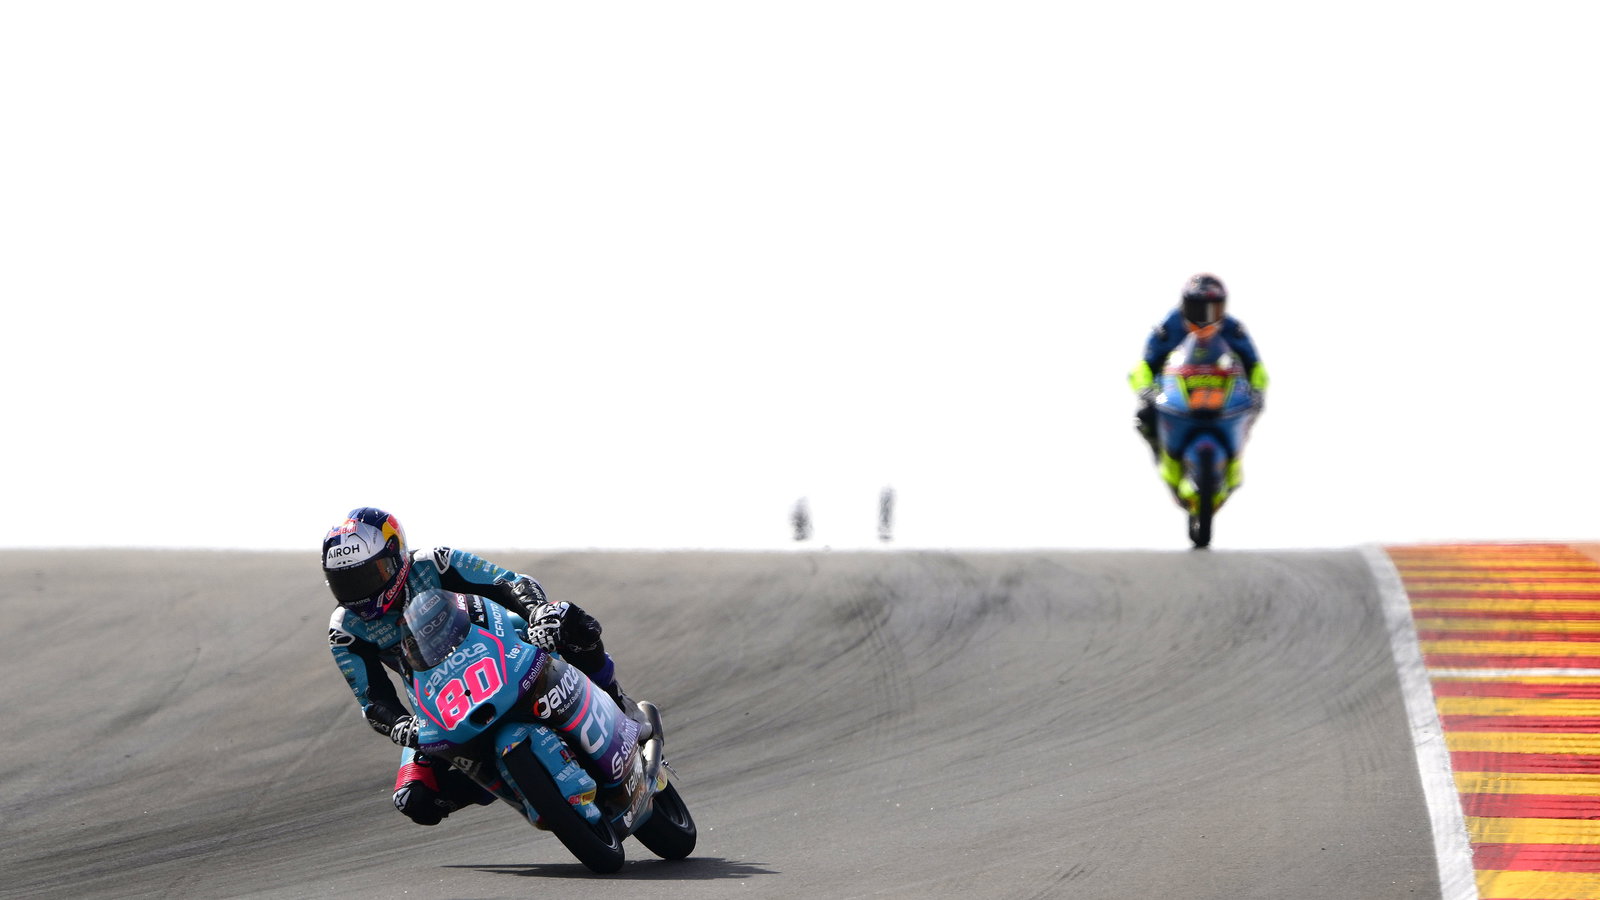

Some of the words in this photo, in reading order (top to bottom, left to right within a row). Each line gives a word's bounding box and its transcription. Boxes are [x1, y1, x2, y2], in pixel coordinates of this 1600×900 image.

[328, 544, 360, 559] AIROH
[490, 603, 504, 637] CFMOTO
[424, 642, 488, 700] gaviota
[528, 652, 546, 679] solunion
[435, 657, 503, 730] 80
[533, 664, 579, 719] gaviota
[621, 718, 638, 760] solunion
